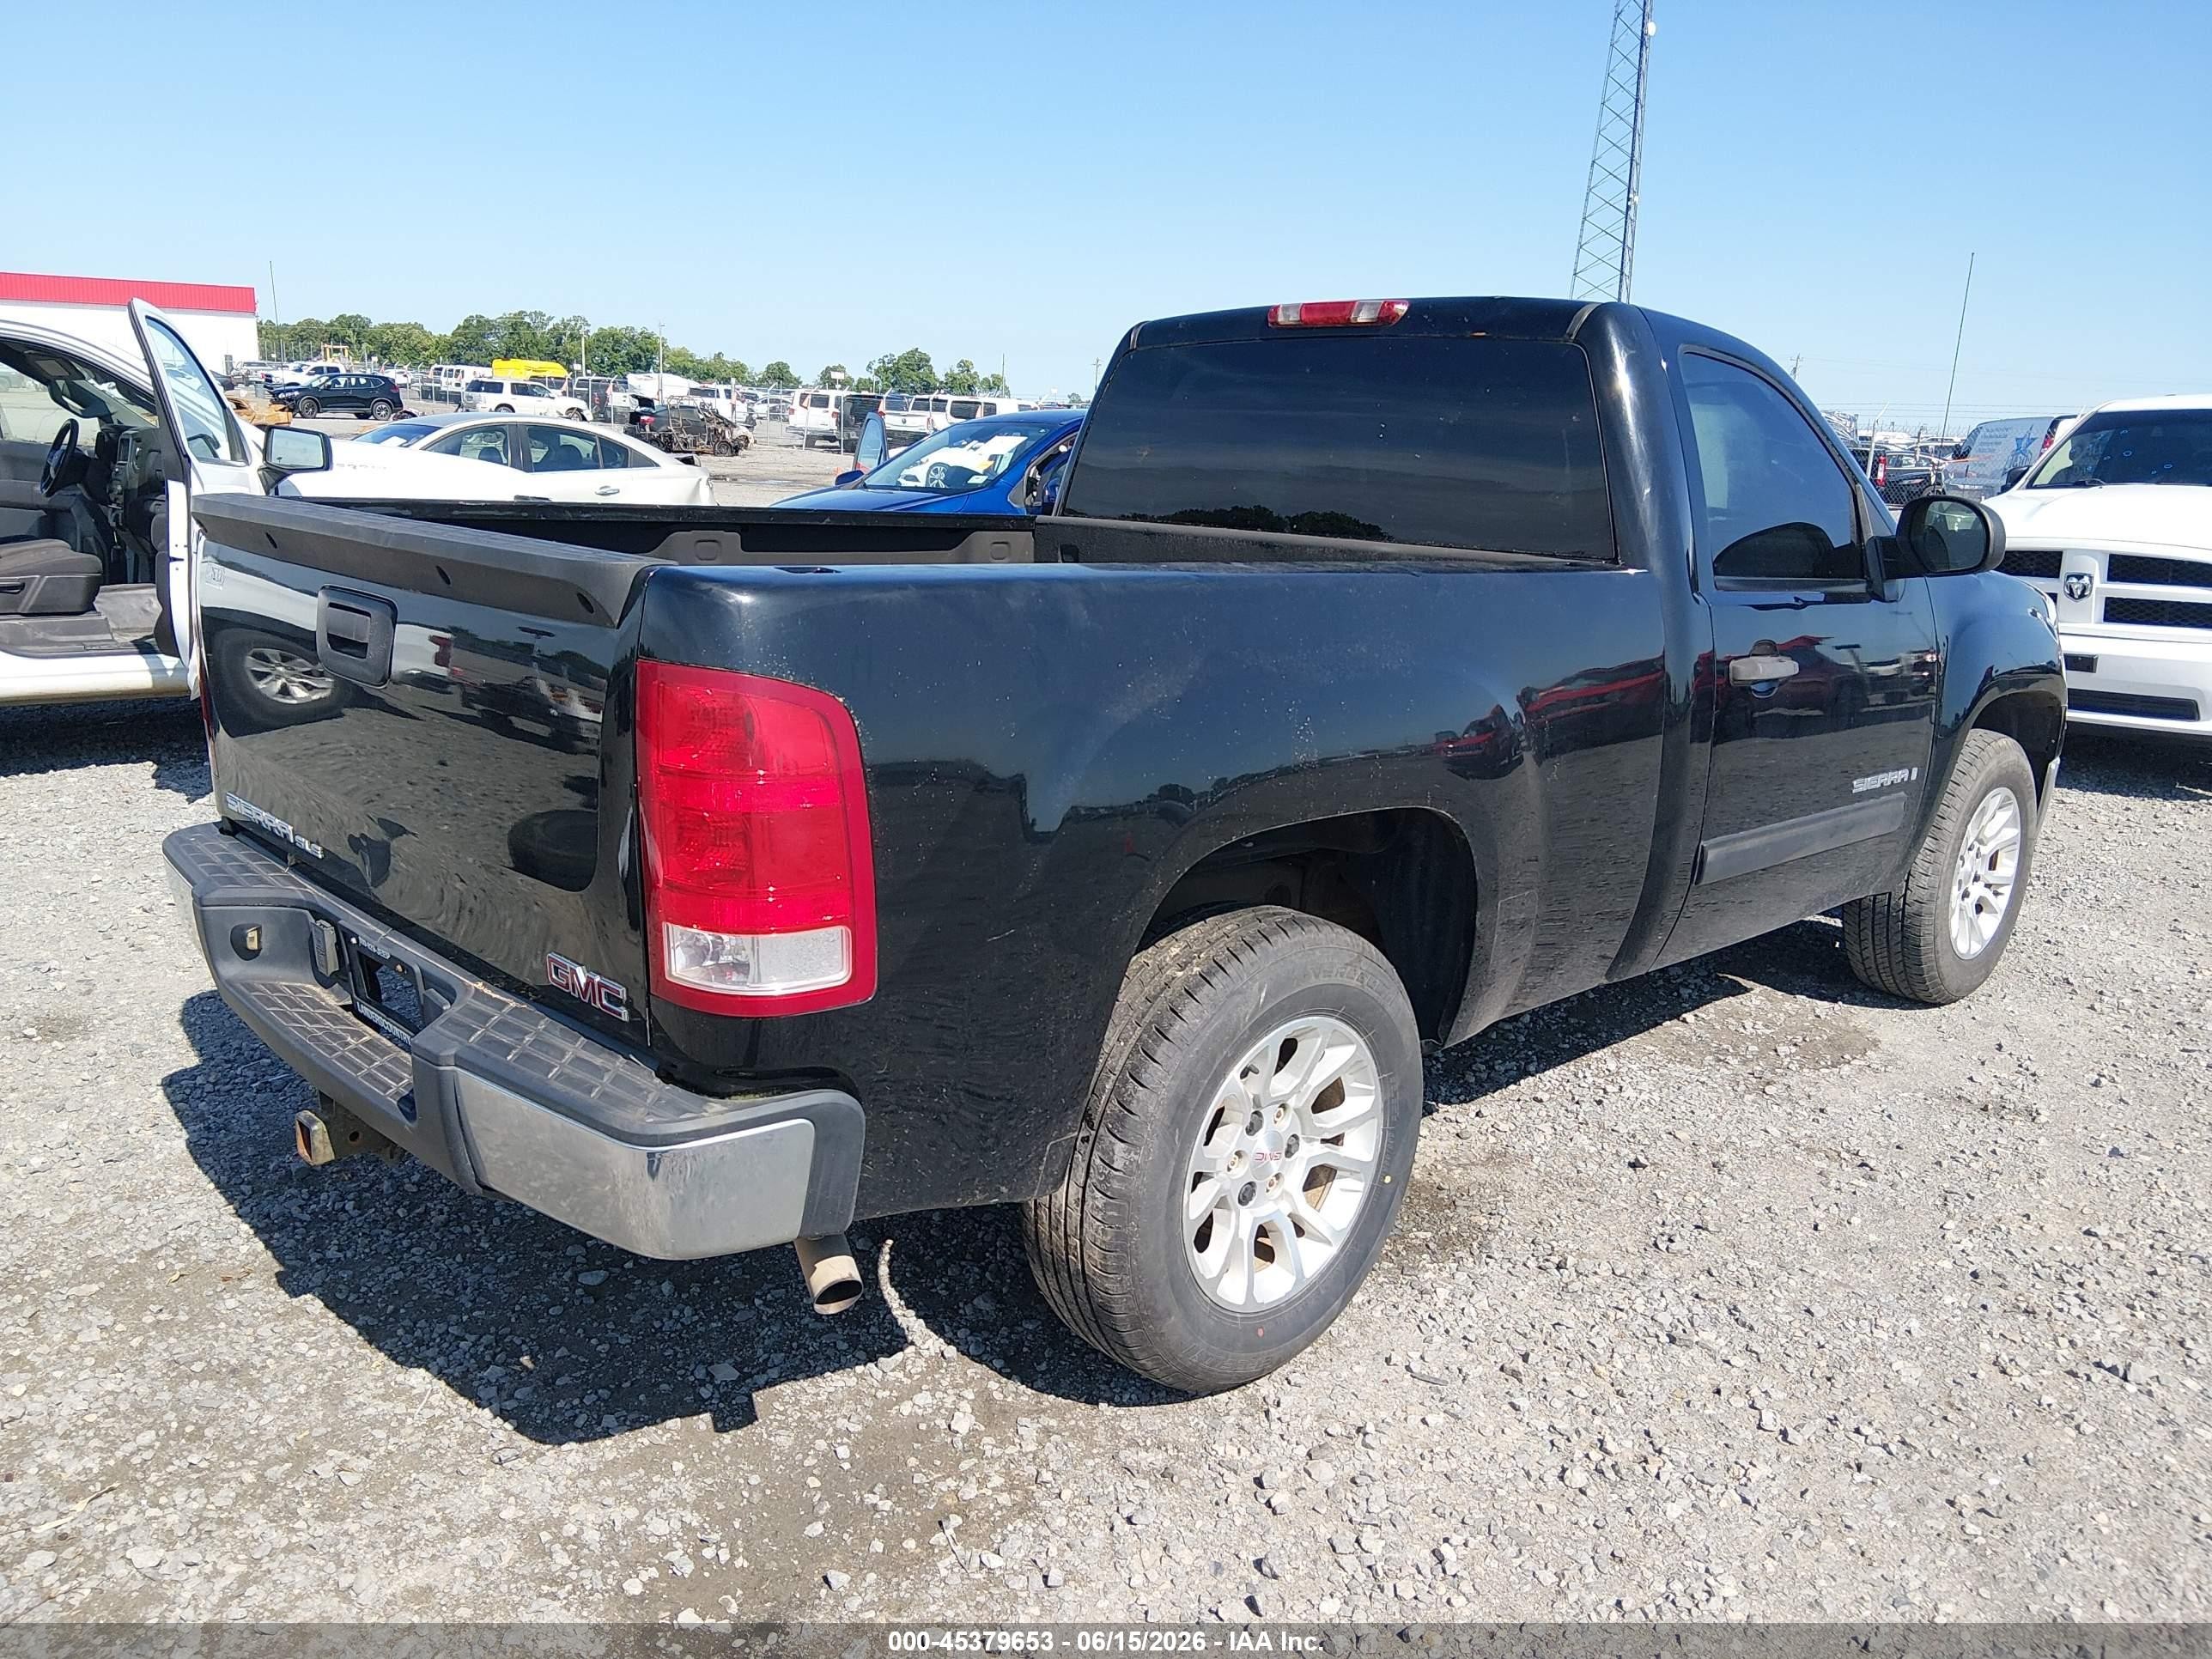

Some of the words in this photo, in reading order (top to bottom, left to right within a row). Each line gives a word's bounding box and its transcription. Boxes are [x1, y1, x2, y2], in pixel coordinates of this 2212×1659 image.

[1852, 769, 1909, 793] SIERRA
[226, 792, 294, 843] SIERRA
[547, 951, 629, 1022] GMC
